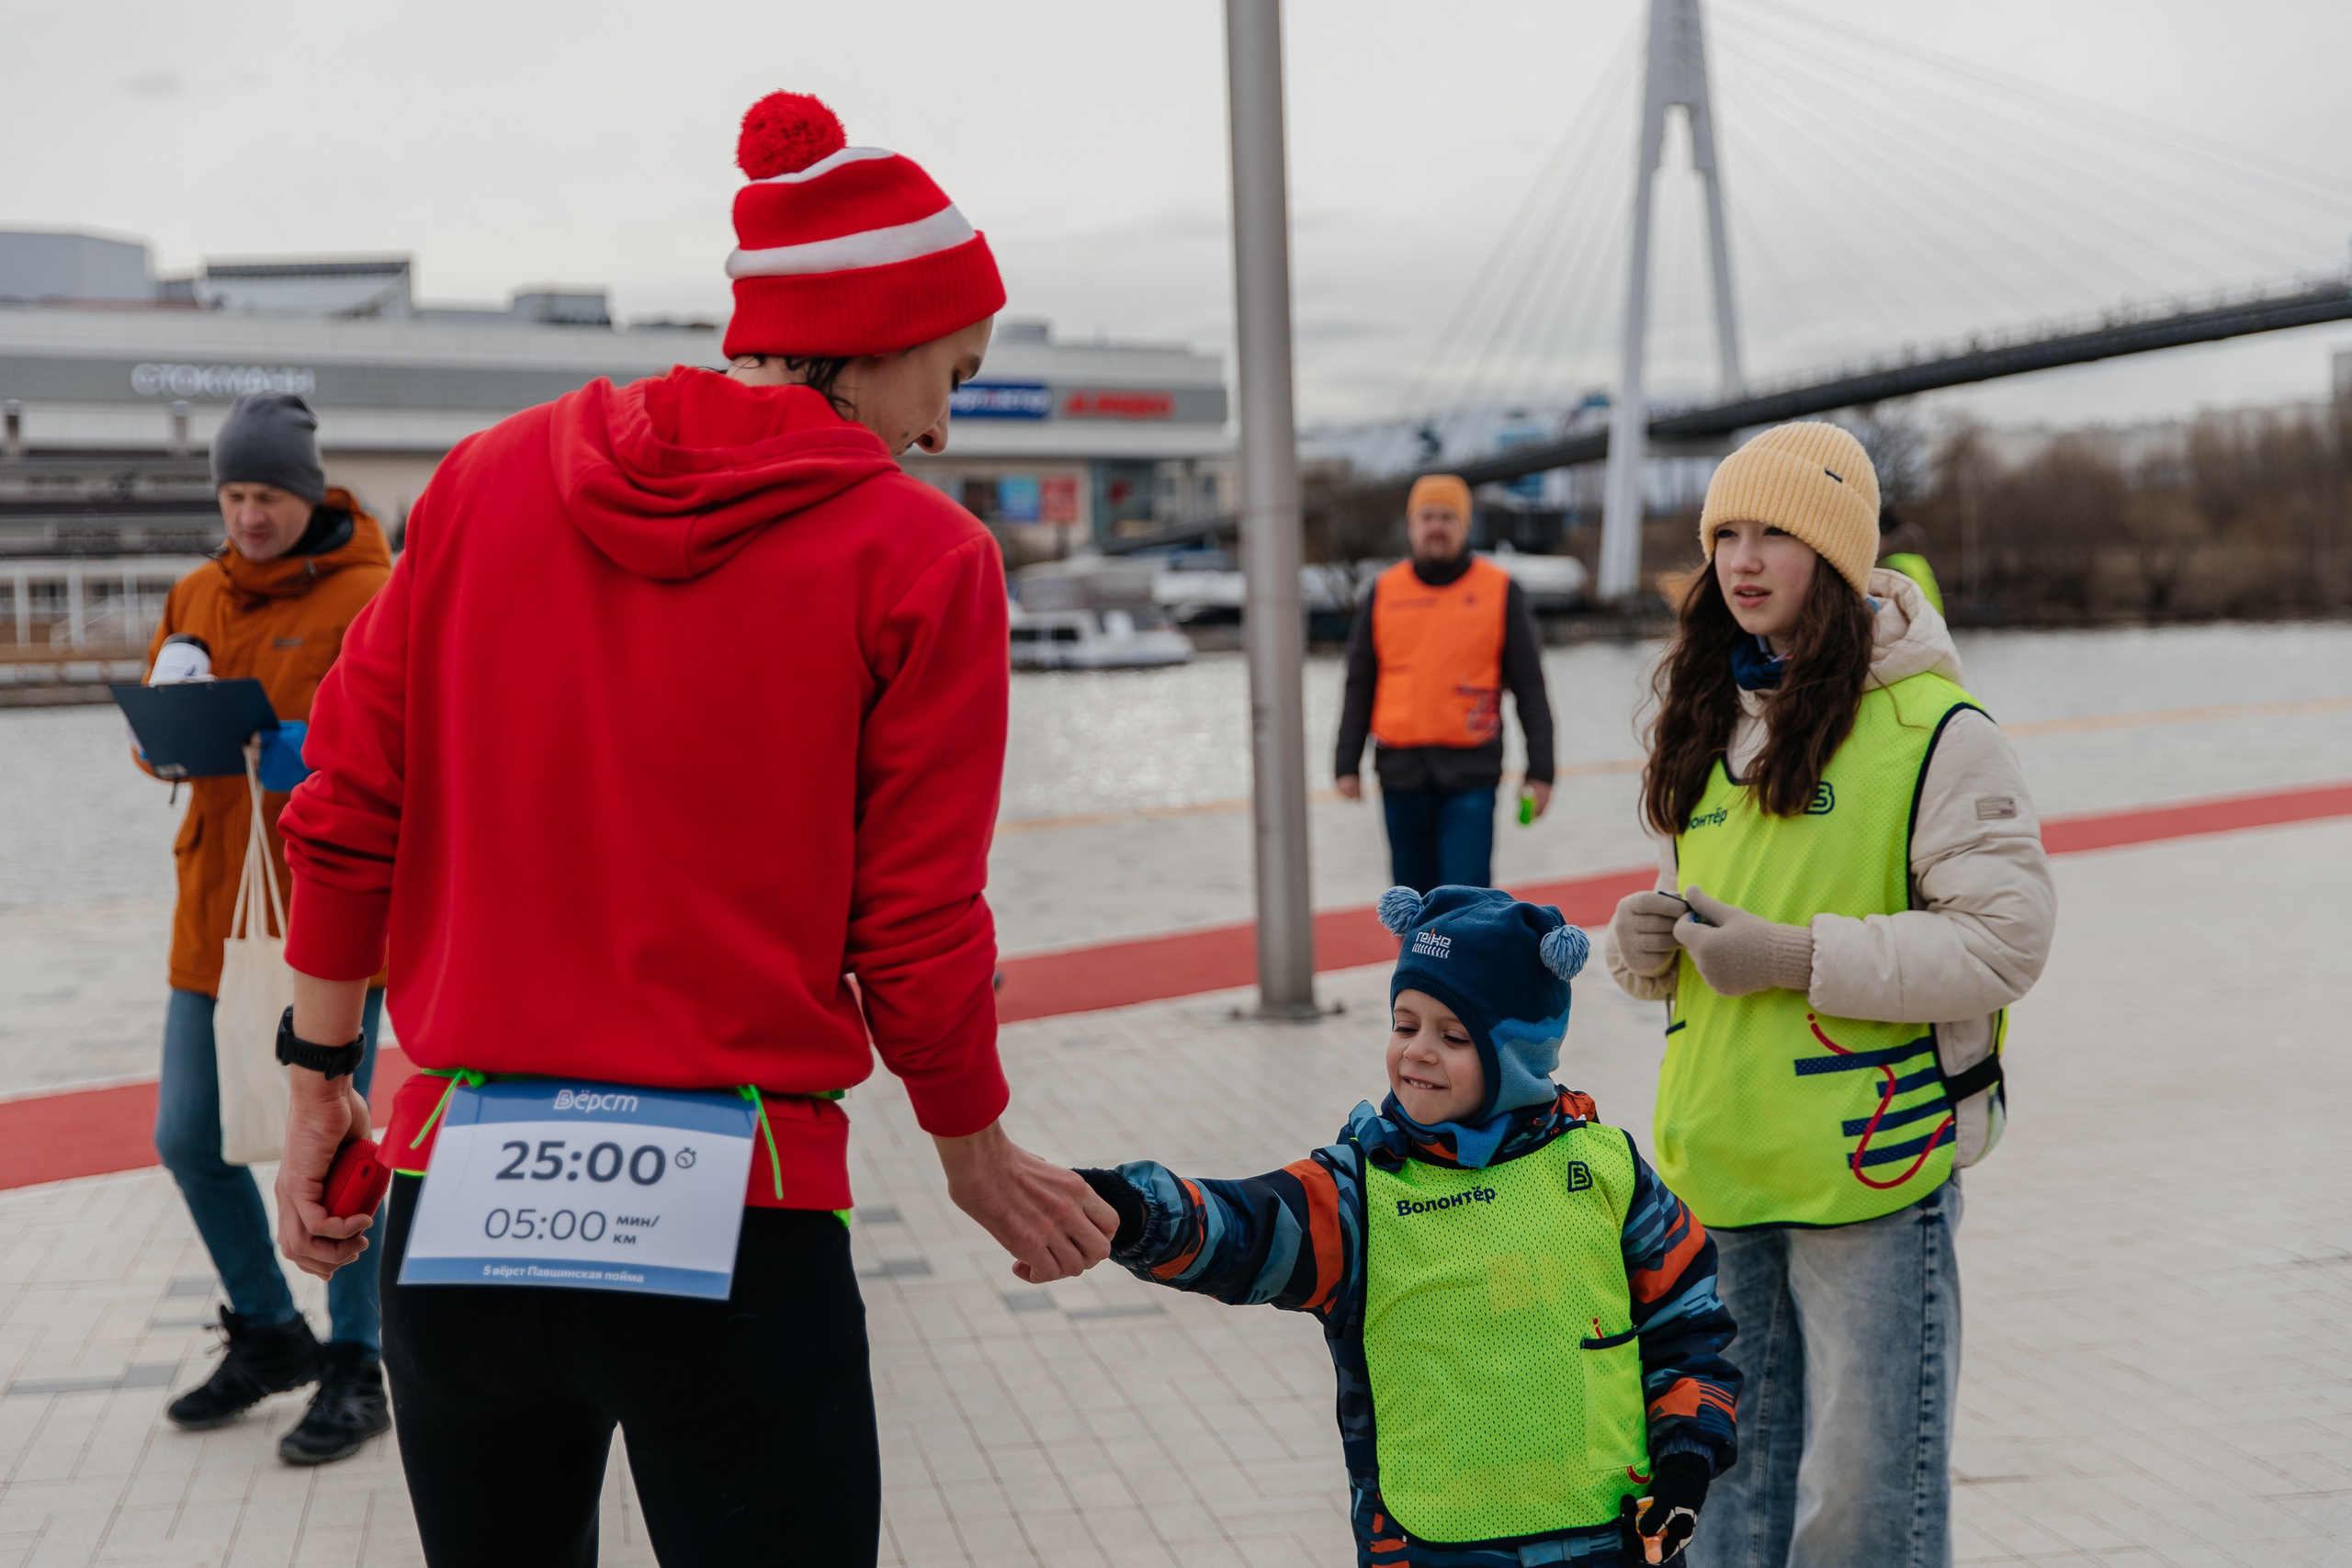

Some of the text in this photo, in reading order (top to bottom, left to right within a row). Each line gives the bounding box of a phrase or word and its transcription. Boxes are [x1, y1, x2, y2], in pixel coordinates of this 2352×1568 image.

[494, 1139, 667, 1186] 25:00
[1396, 1186, 1497, 1217] Волонтёр
[483, 1207, 661, 1242] 05:00 мин/
[613, 1233, 638, 1246] км
[482, 1265, 645, 1283] 5 вёрст Павшинская пойма
